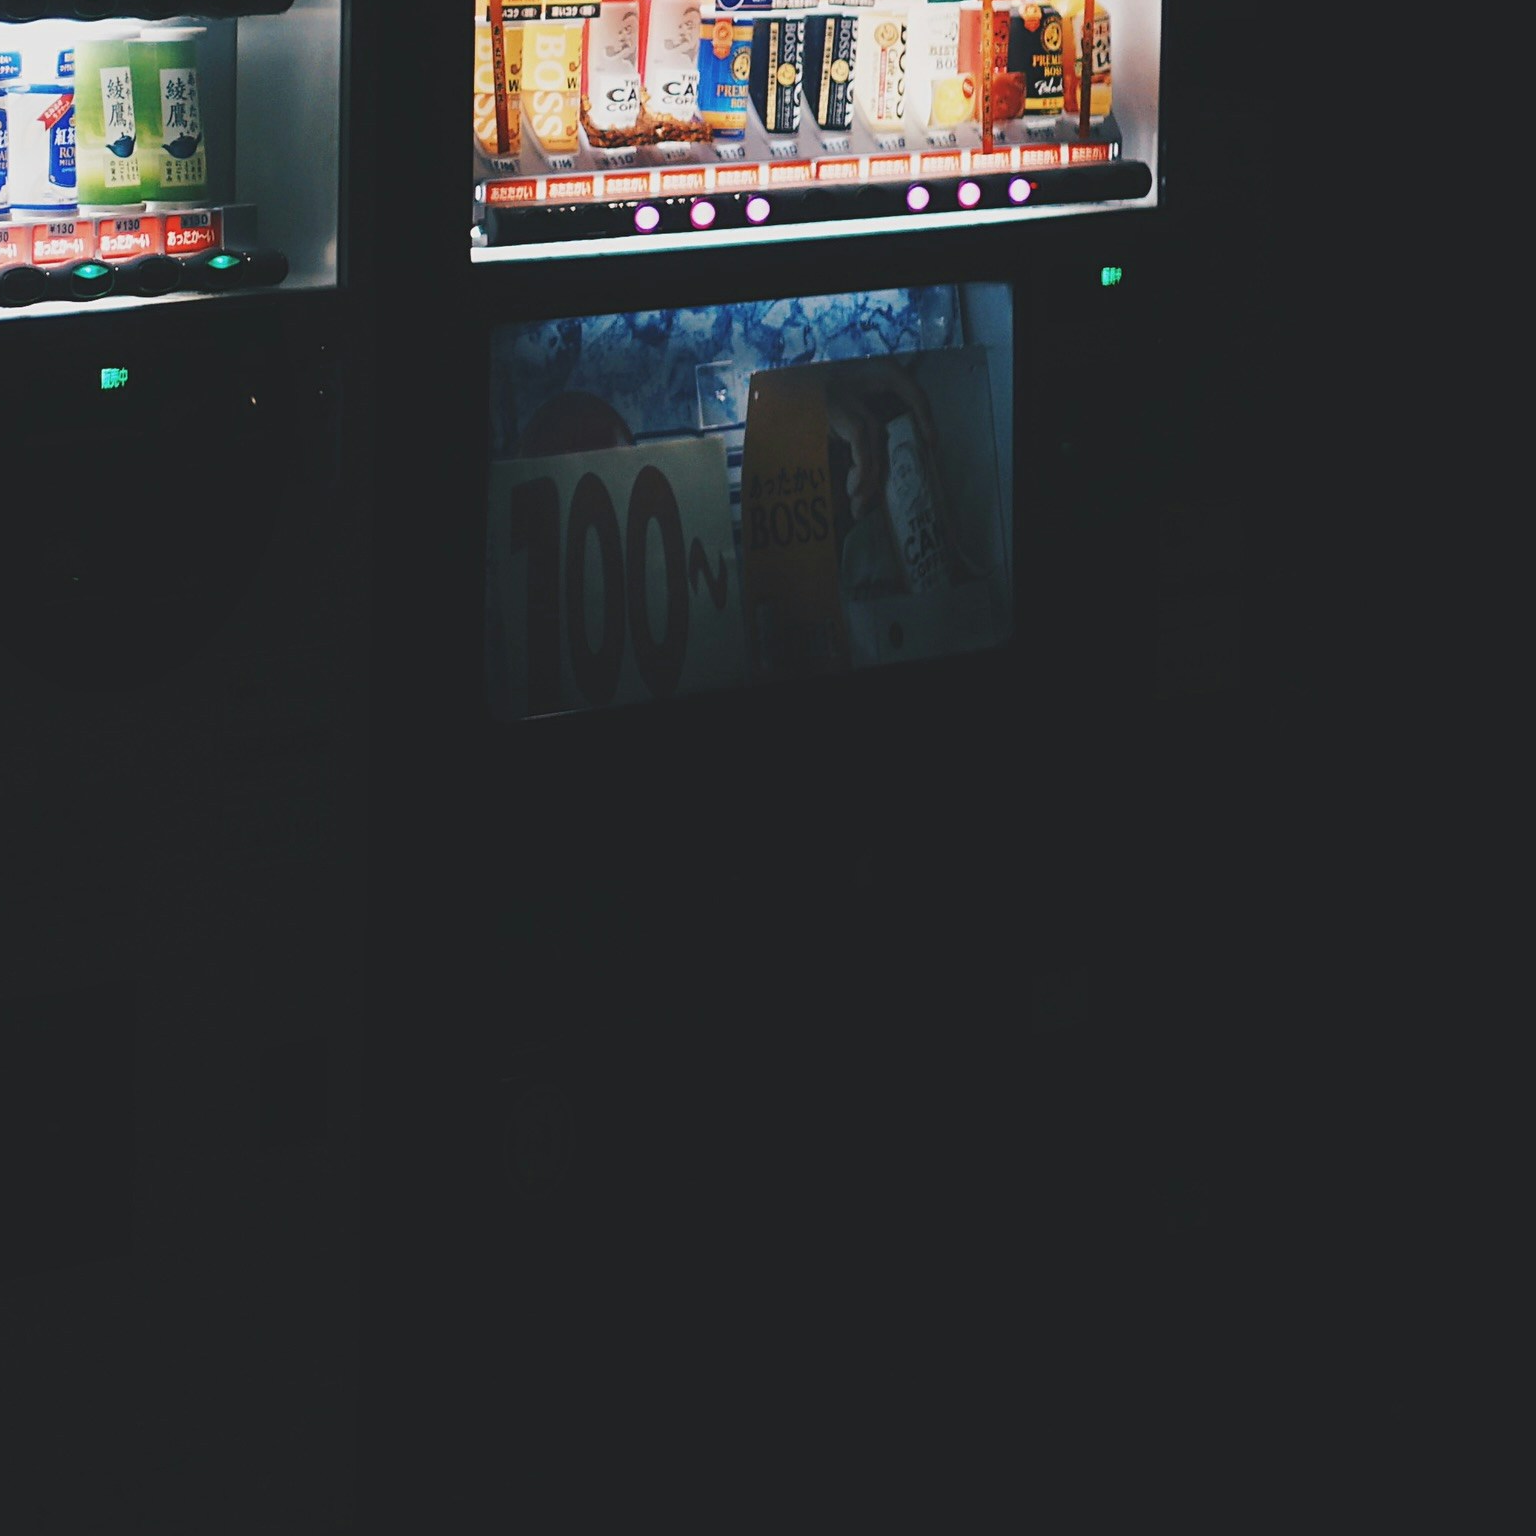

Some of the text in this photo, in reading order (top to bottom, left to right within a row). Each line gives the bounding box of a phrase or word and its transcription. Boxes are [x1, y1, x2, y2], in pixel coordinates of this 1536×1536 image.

[107, 79, 127, 128] 綾鷹
[166, 78, 188, 128] 綾鷹
[532, 33, 566, 139] BOSS
[748, 467, 826, 499] あったかい
[748, 497, 829, 552] BOSS
